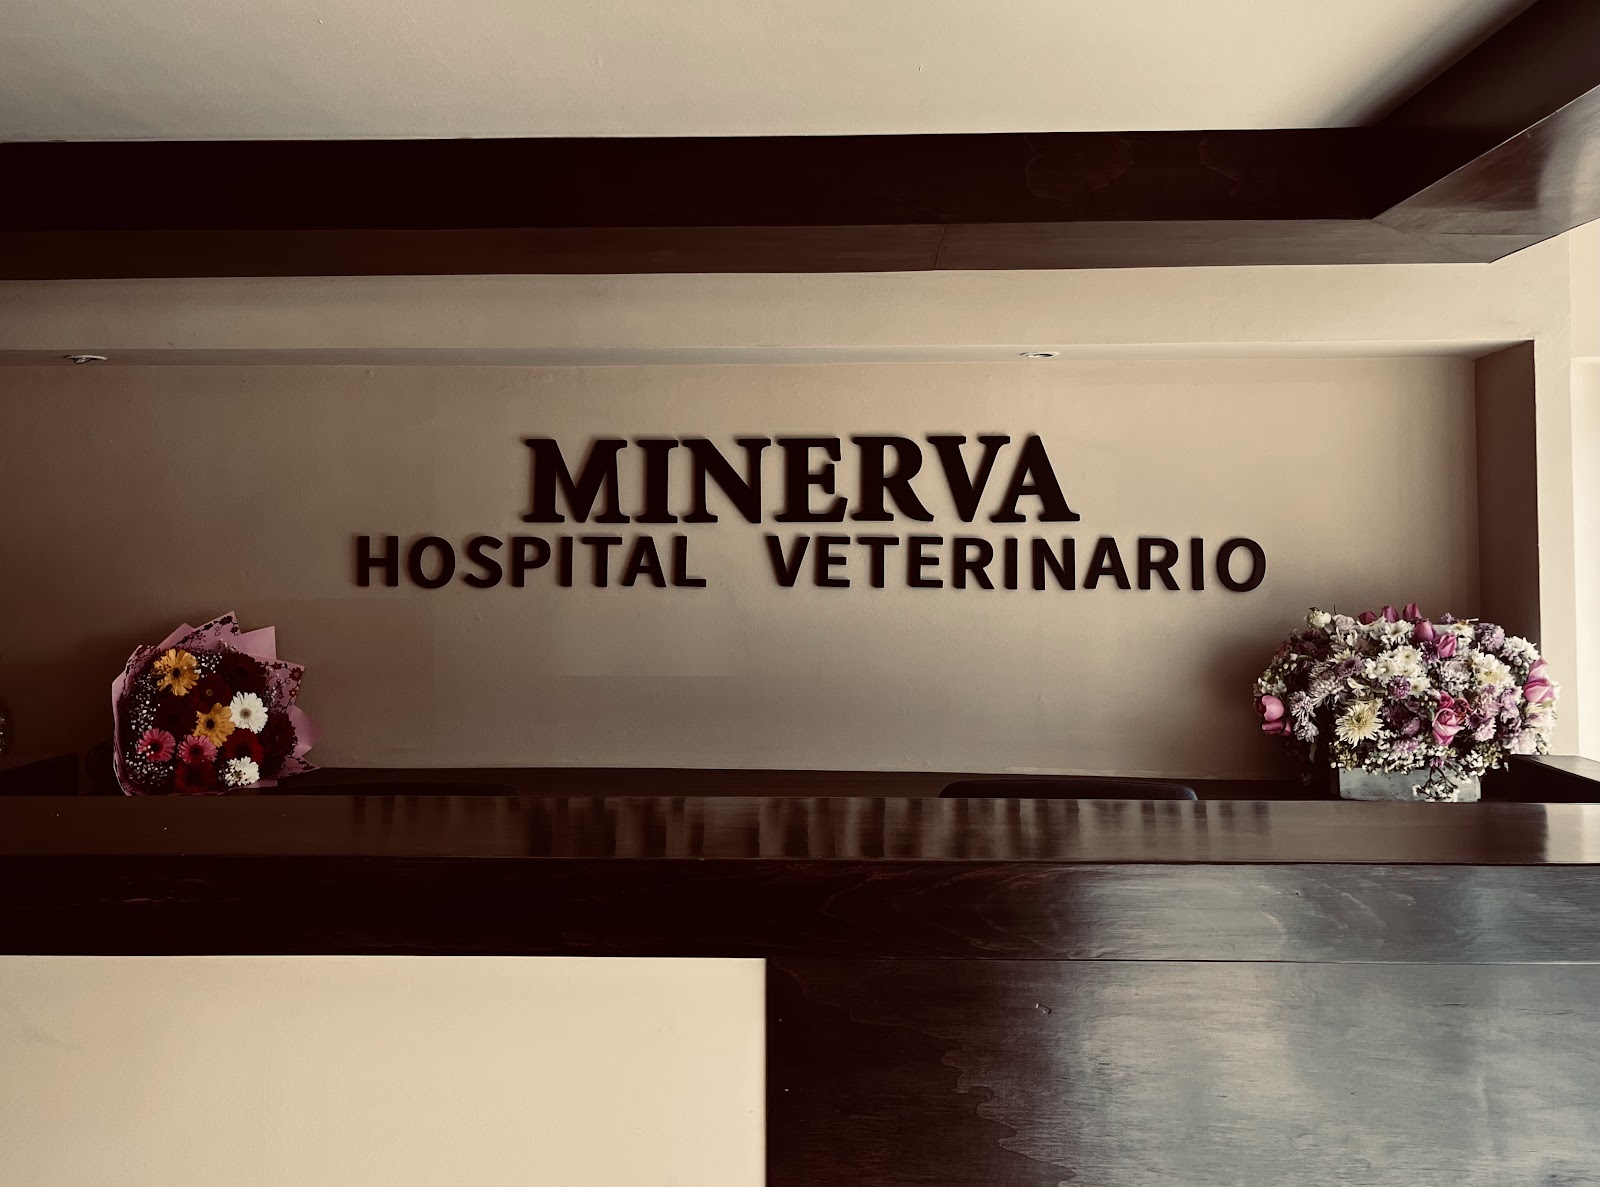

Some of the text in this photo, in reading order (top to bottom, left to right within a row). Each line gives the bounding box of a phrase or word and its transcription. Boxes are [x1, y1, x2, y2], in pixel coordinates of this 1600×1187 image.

[521, 435, 1080, 524] MINERVA
[353, 535, 1267, 593] HOSPITAL VETERINARIO
